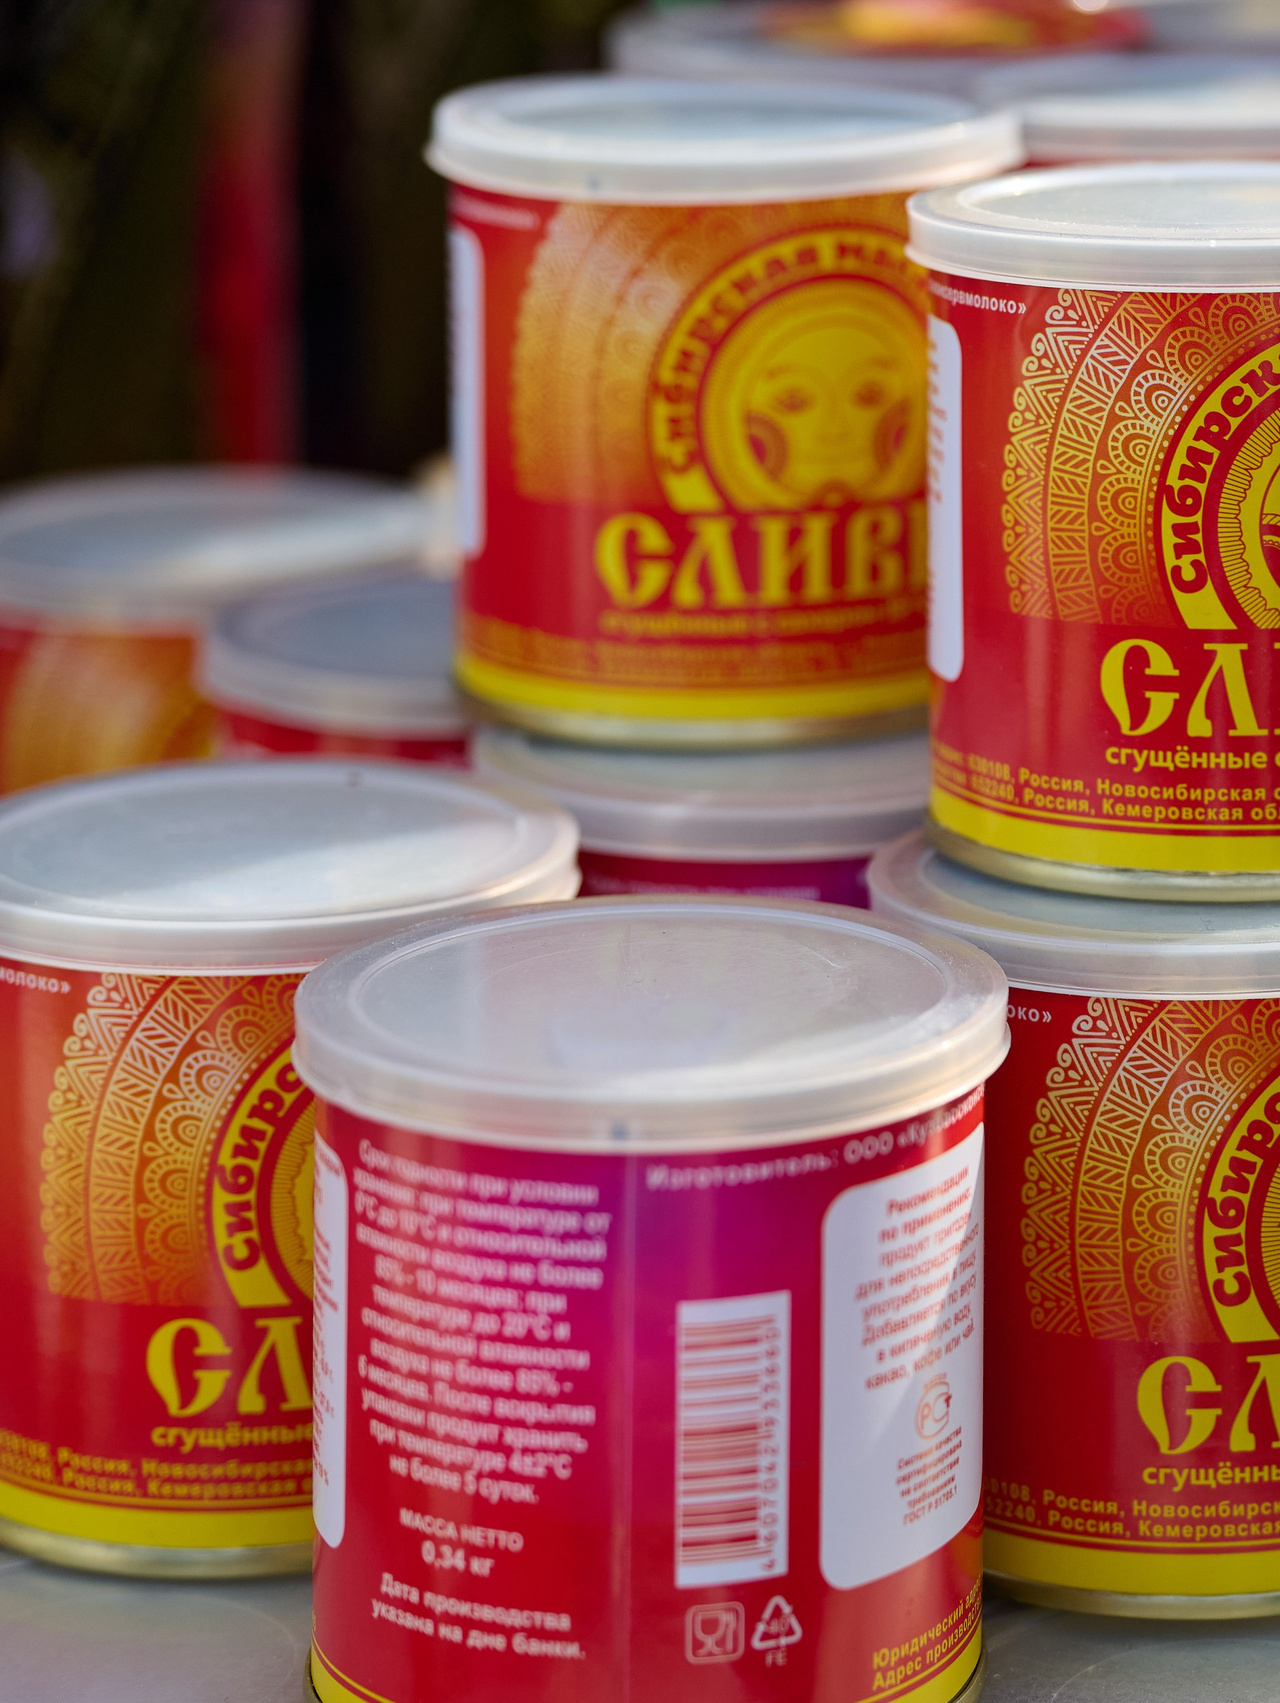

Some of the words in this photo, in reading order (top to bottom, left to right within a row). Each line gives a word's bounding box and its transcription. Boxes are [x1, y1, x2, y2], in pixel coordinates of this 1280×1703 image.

[595, 500, 929, 609] СЛИВ
[1105, 745, 1268, 773] сгущённые
[1019, 767, 1091, 796] Россия,
[1096, 777, 1267, 804] Новосибирская
[1023, 787, 1096, 816] Россия,
[1102, 798, 1243, 823] Кемеровская
[216, 1061, 308, 1272] Сибирс
[369, 1418, 396, 1446] при
[390, 1454, 409, 1478] не
[409, 1456, 462, 1495] более
[1043, 1489, 1126, 1519] Россия,
[400, 1507, 458, 1541] МАССА
[459, 1523, 524, 1553] НЕТТО
[1047, 1509, 1132, 1538] Россия,
[469, 1554, 496, 1578] кг
[380, 1571, 421, 1605] Дата
[422, 1590, 572, 1633] производства
[371, 1598, 434, 1637] указана
[438, 1622, 463, 1645] на
[465, 1628, 508, 1652] дне
[872, 1599, 963, 1670] Юридический
[871, 1656, 922, 1691] Адрес
